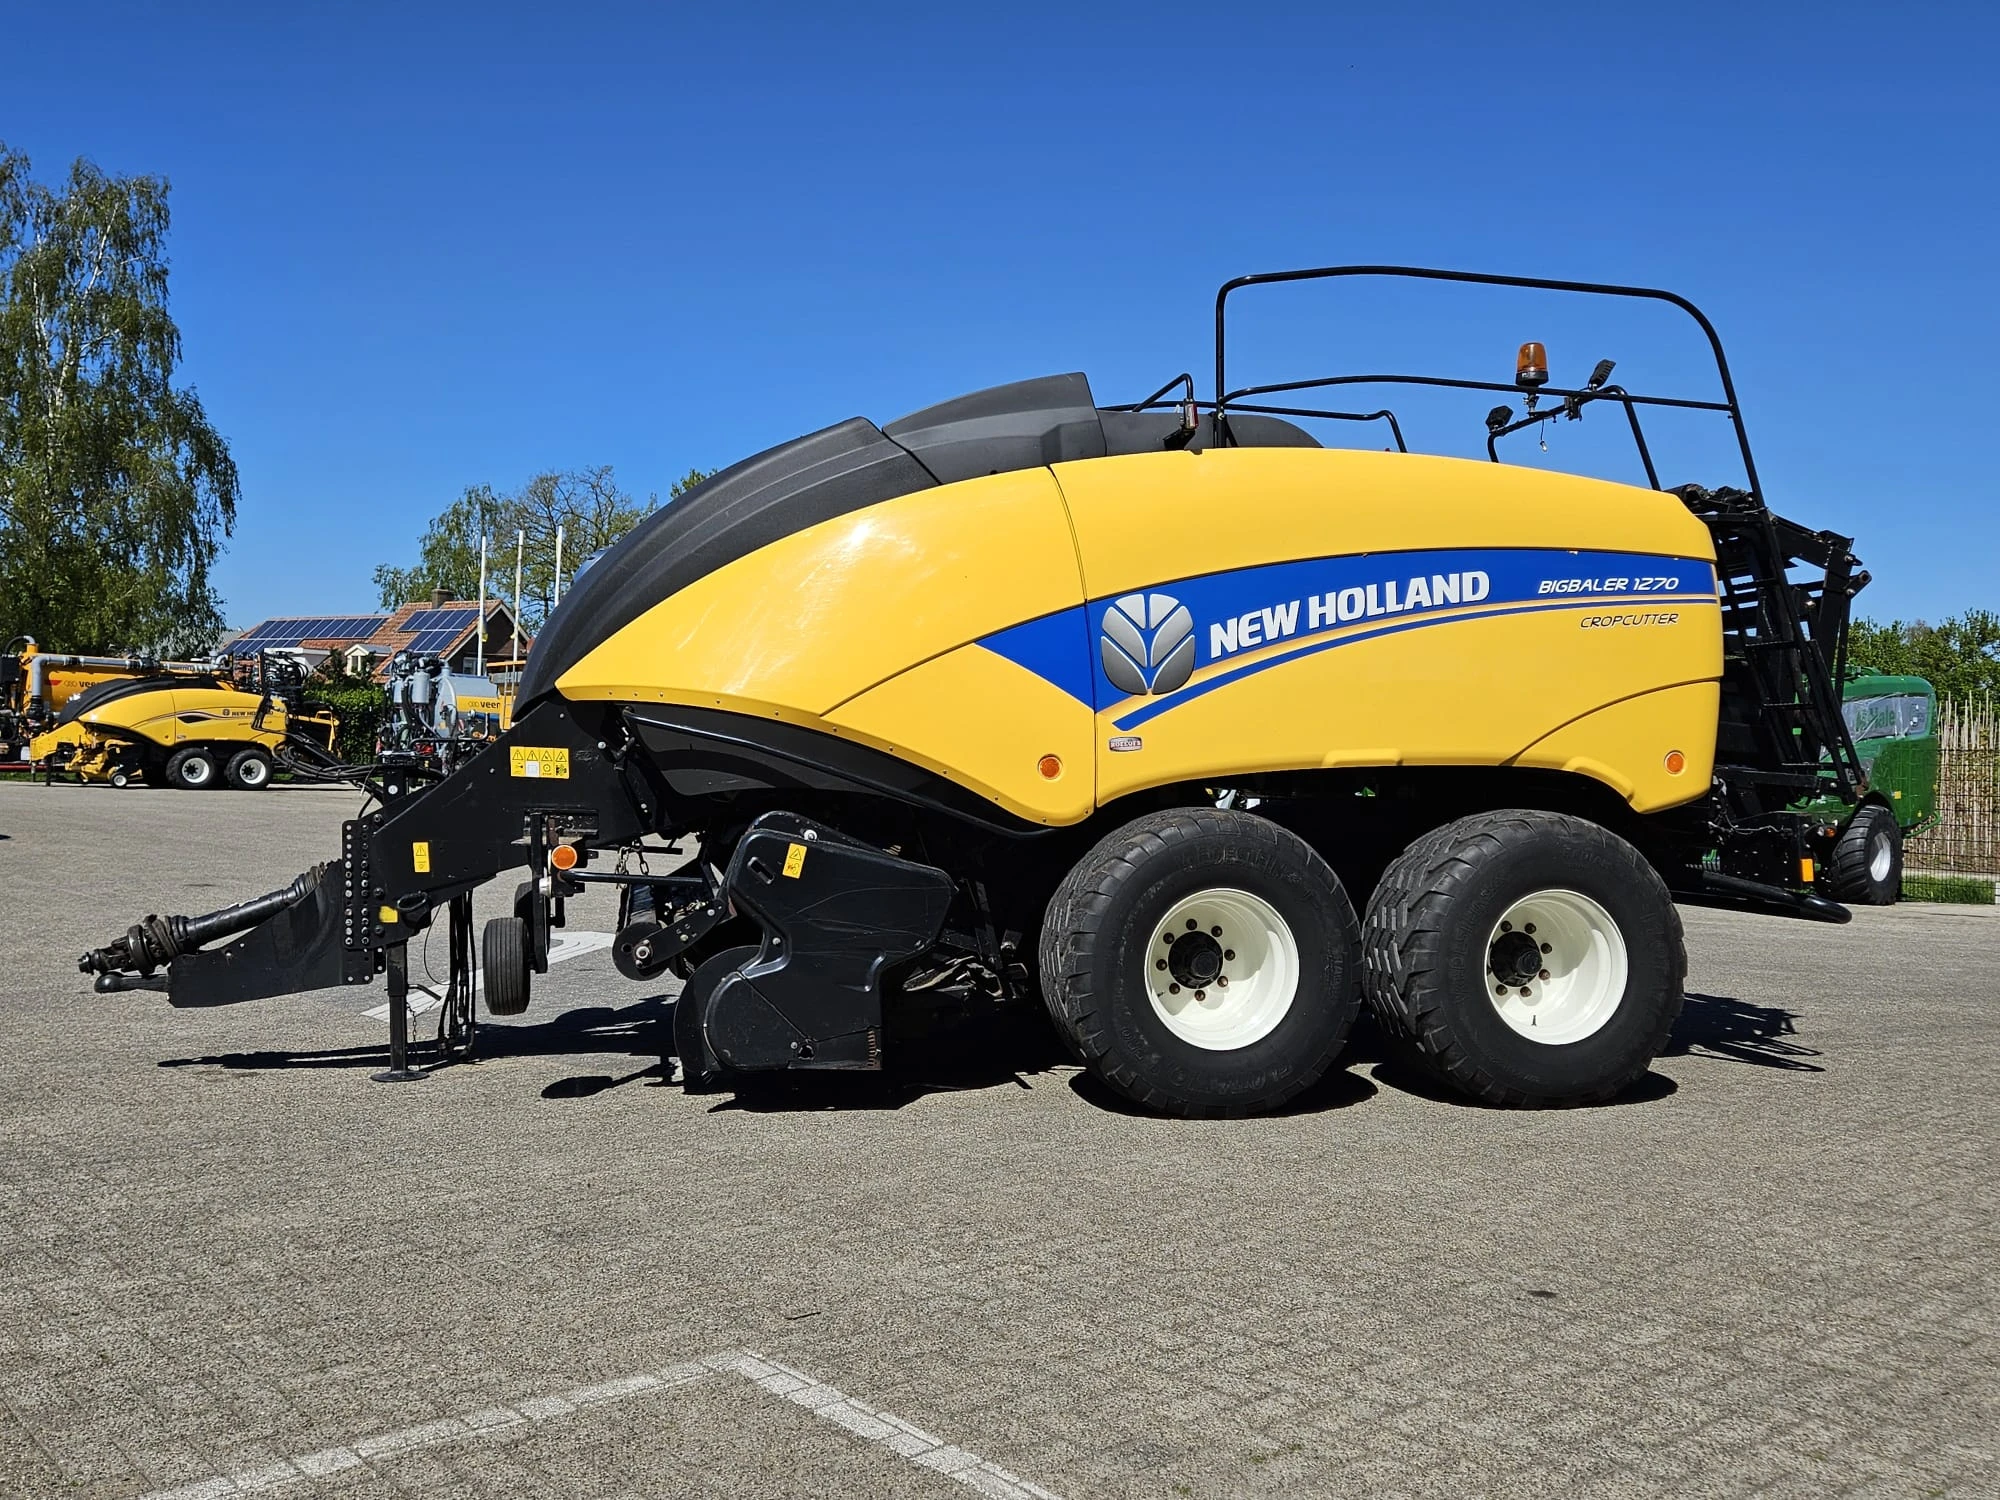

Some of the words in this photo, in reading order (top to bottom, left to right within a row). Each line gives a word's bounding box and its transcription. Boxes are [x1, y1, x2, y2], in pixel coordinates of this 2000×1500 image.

[1538, 577, 1629, 594] BIGBALER
[1633, 577, 1680, 591] 1270
[1209, 599, 1301, 659] NEW
[1308, 570, 1491, 630] HOLLAND
[1580, 613, 1680, 629] CROPCUTTER
[79, 680, 96, 689] vee
